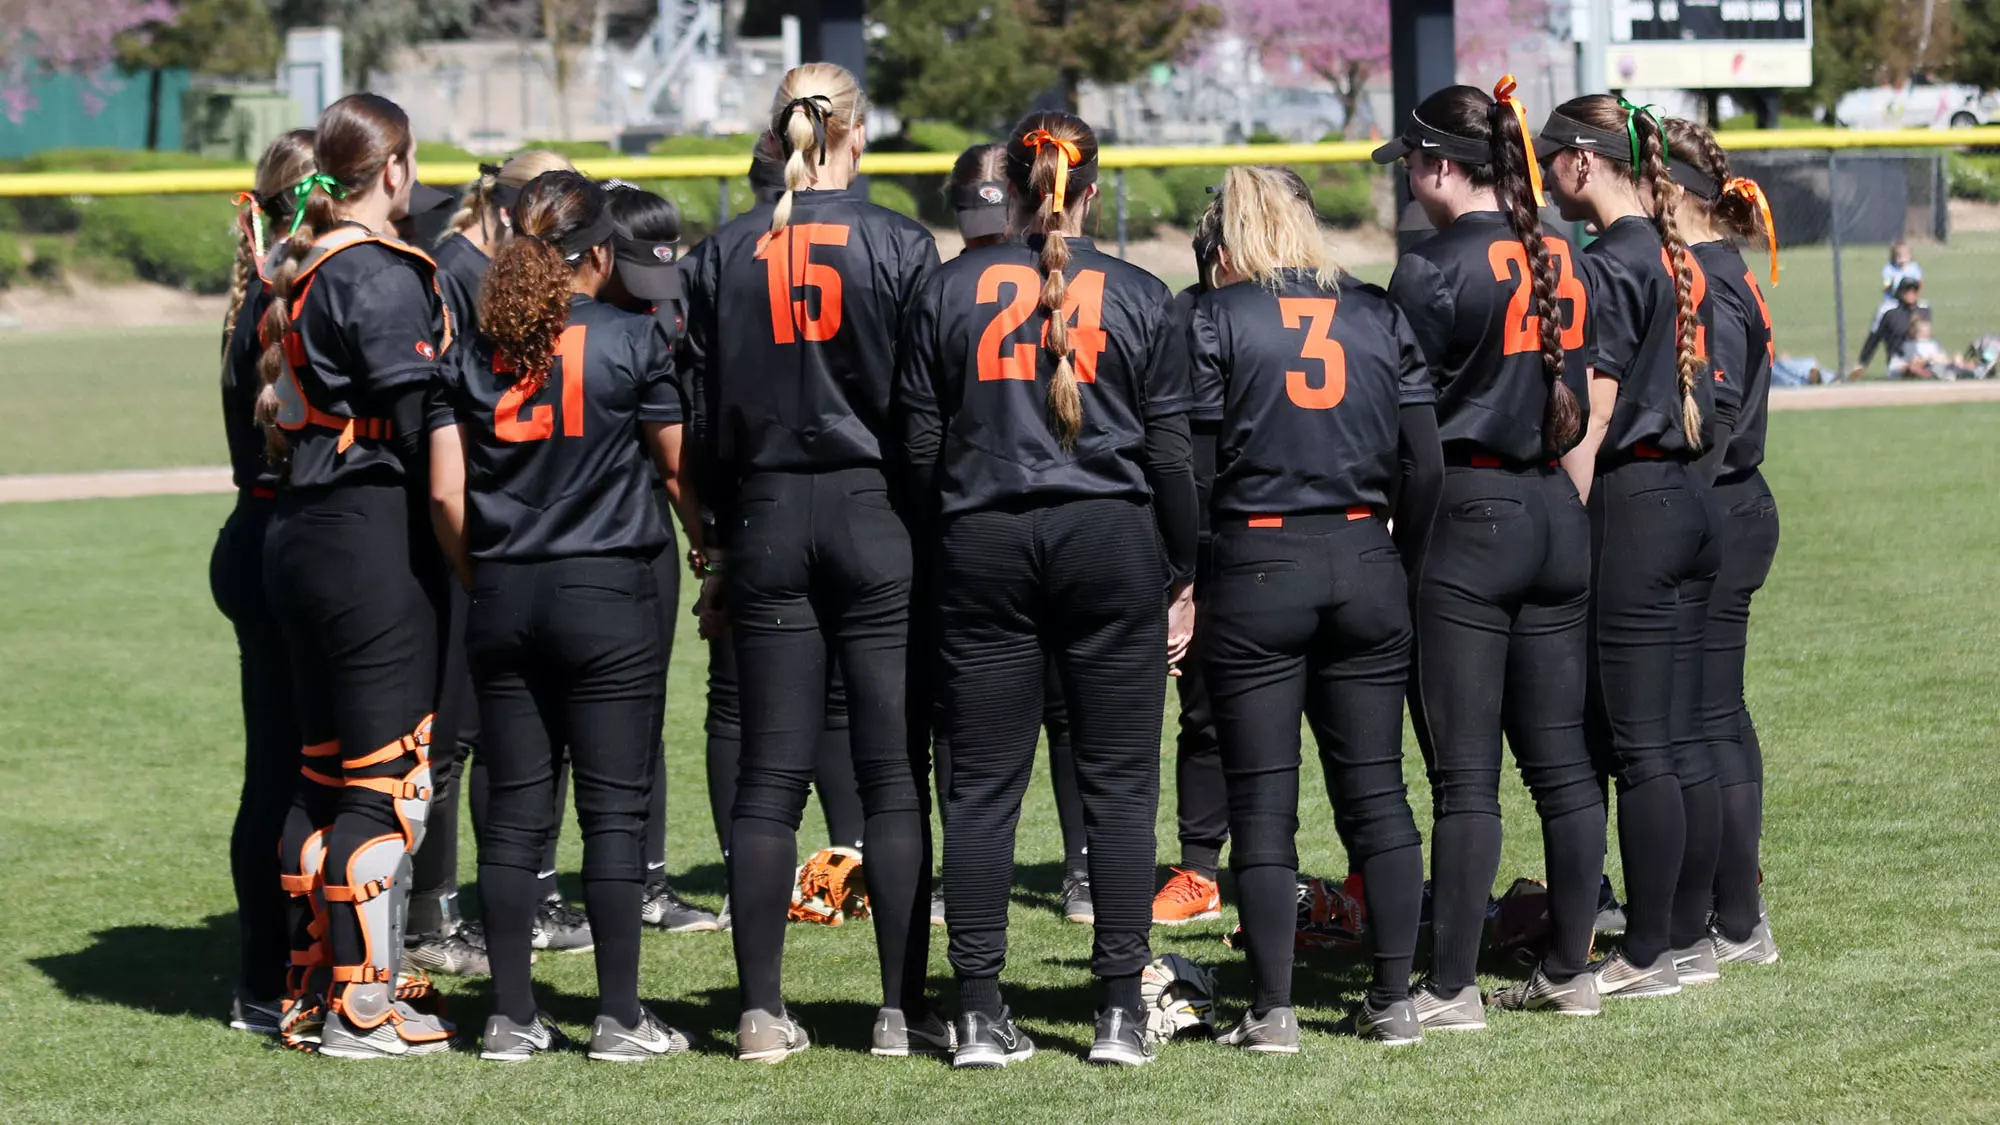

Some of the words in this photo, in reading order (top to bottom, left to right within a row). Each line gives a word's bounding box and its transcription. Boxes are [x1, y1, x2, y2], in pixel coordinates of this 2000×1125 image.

[757, 223, 850, 344] 15
[976, 264, 1107, 384] 24
[1488, 236, 1587, 356] 23
[492, 325, 587, 443] 21
[1278, 297, 1347, 410] 3
